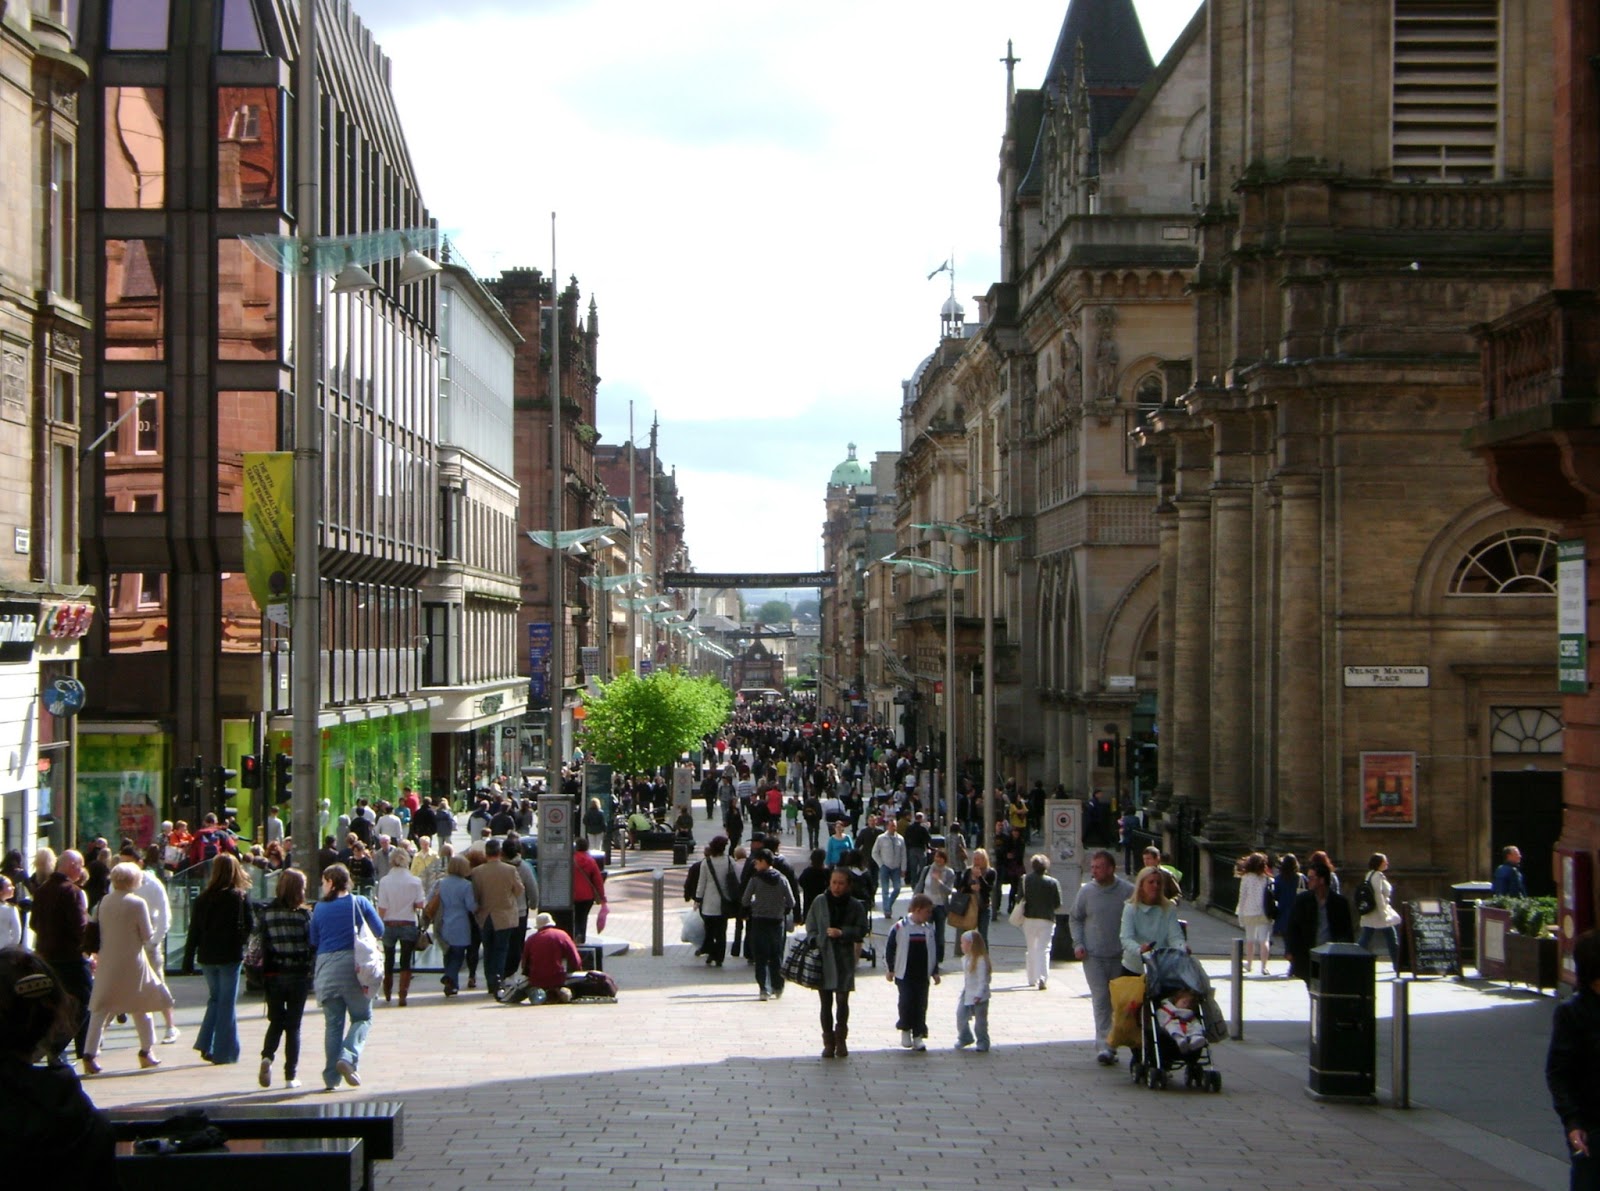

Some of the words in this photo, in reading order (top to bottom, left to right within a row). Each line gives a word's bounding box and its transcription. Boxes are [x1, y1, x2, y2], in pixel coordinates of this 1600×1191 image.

[246, 468, 258, 487] TABLE
[255, 487, 268, 508] TENNIS
[259, 462, 268, 475] THE
[252, 464, 280, 515] COMMONWEALTH
